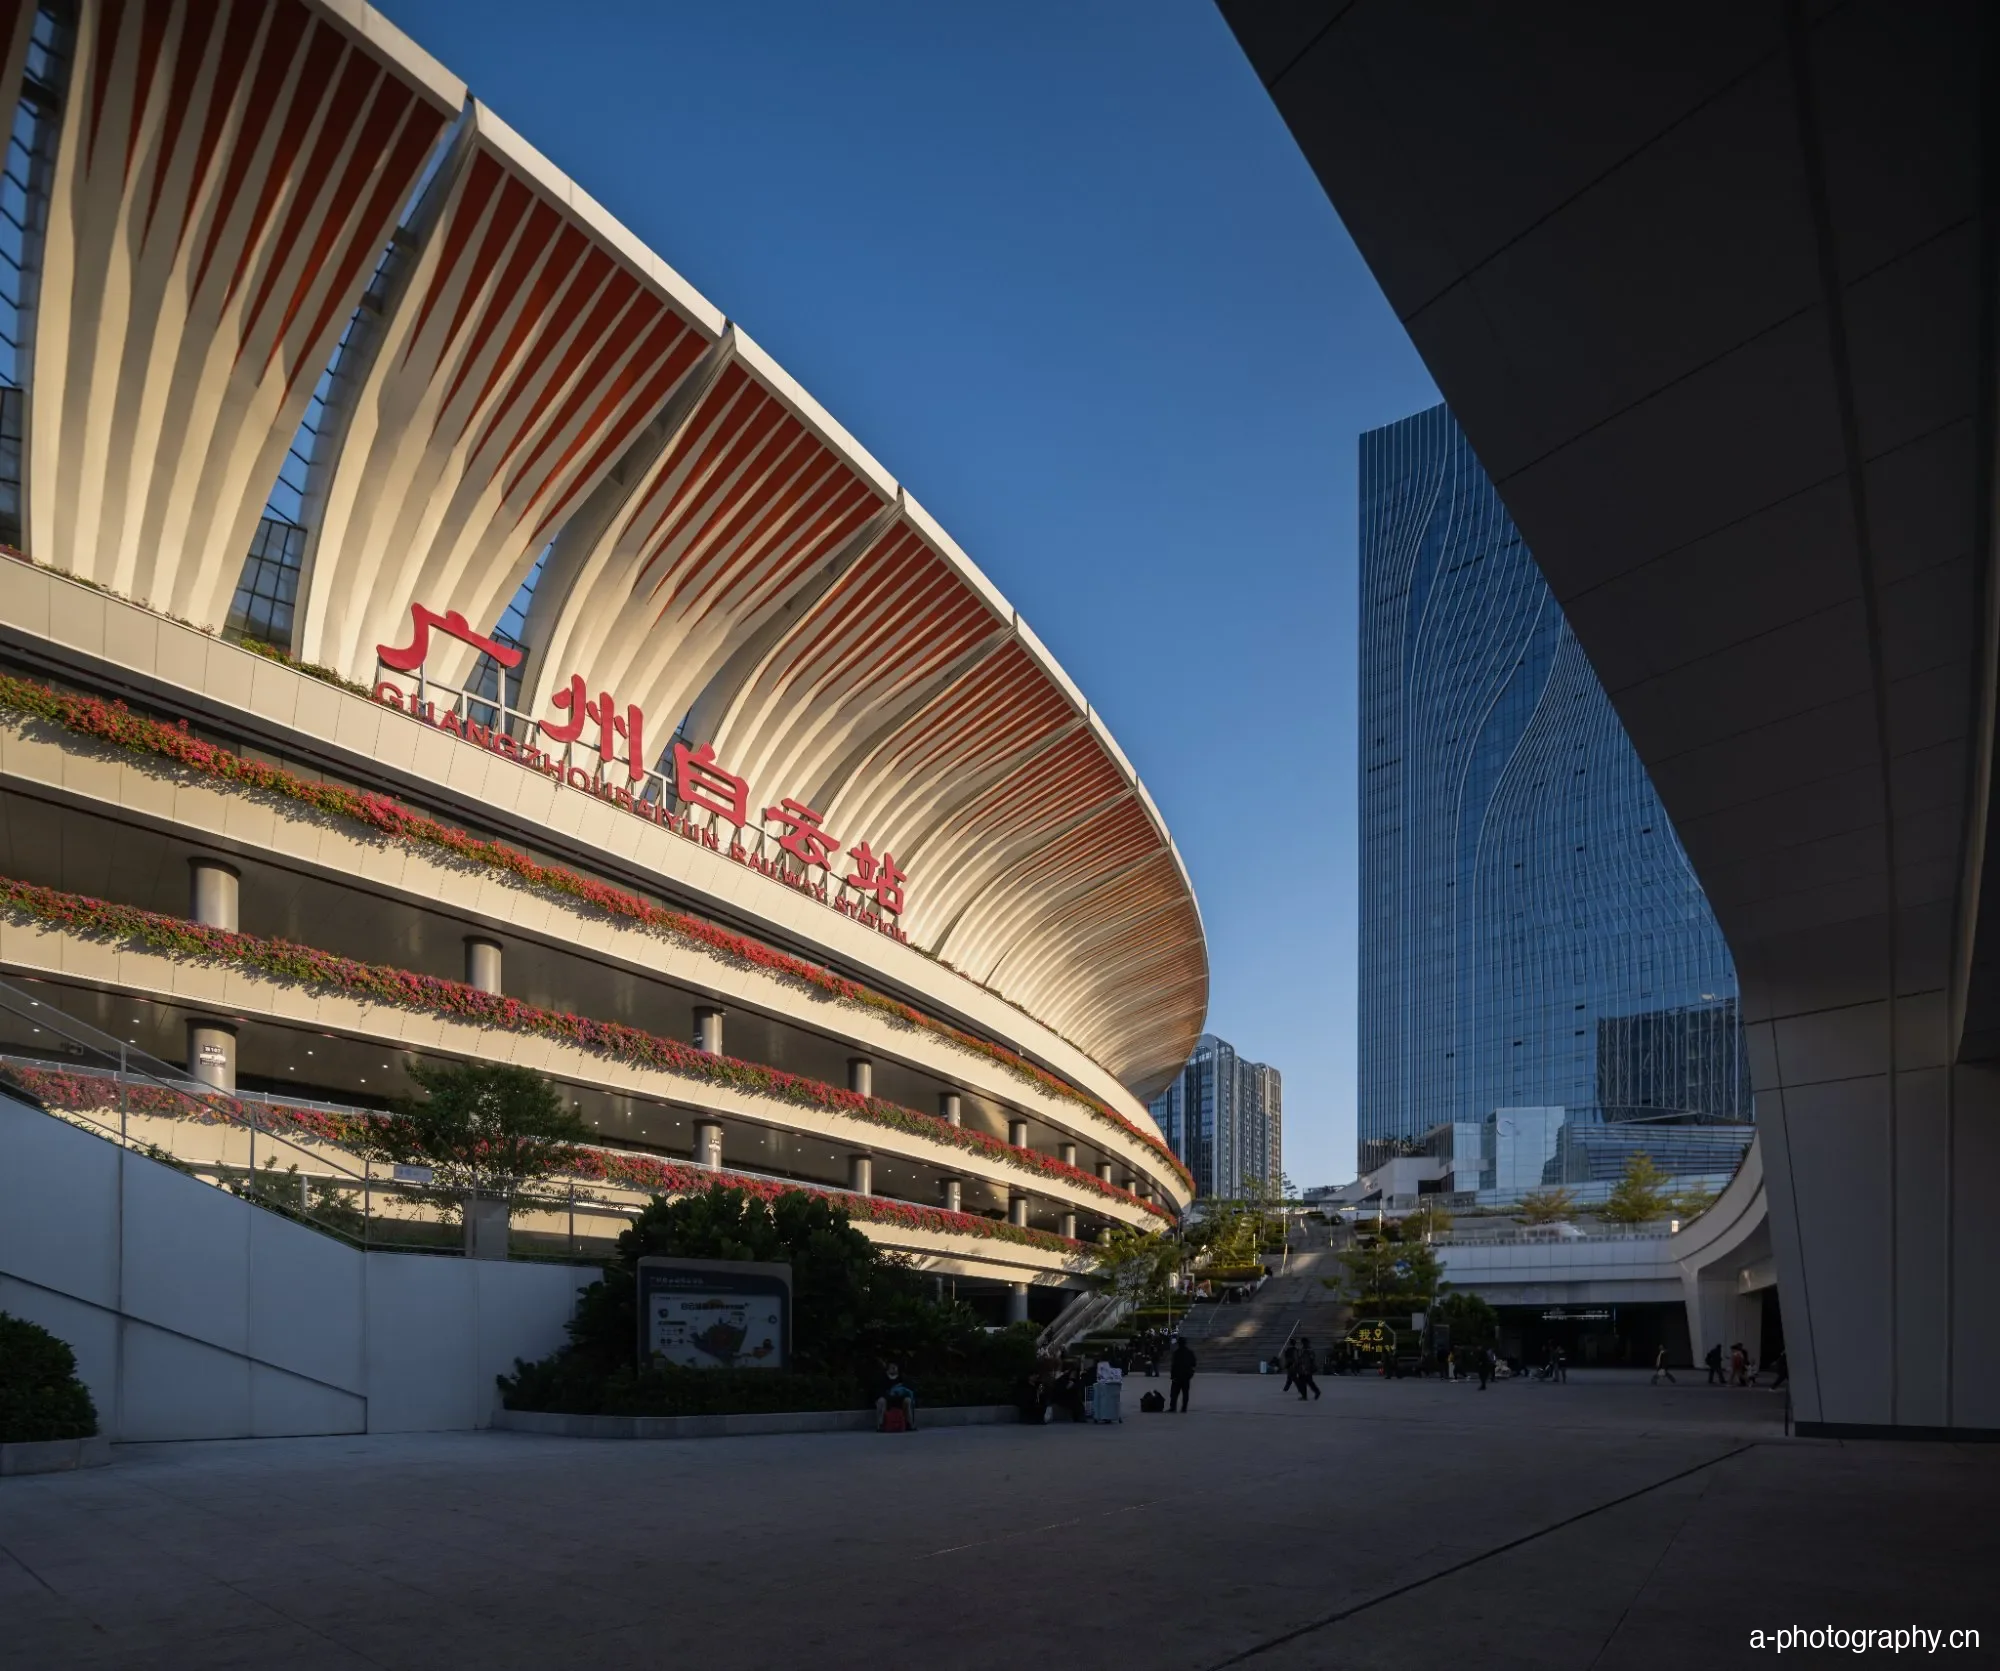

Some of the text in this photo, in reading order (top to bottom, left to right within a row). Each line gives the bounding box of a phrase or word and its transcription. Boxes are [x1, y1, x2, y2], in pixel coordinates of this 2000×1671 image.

[376, 602, 908, 916] 广州白云站
[835, 895, 907, 945] STATION
